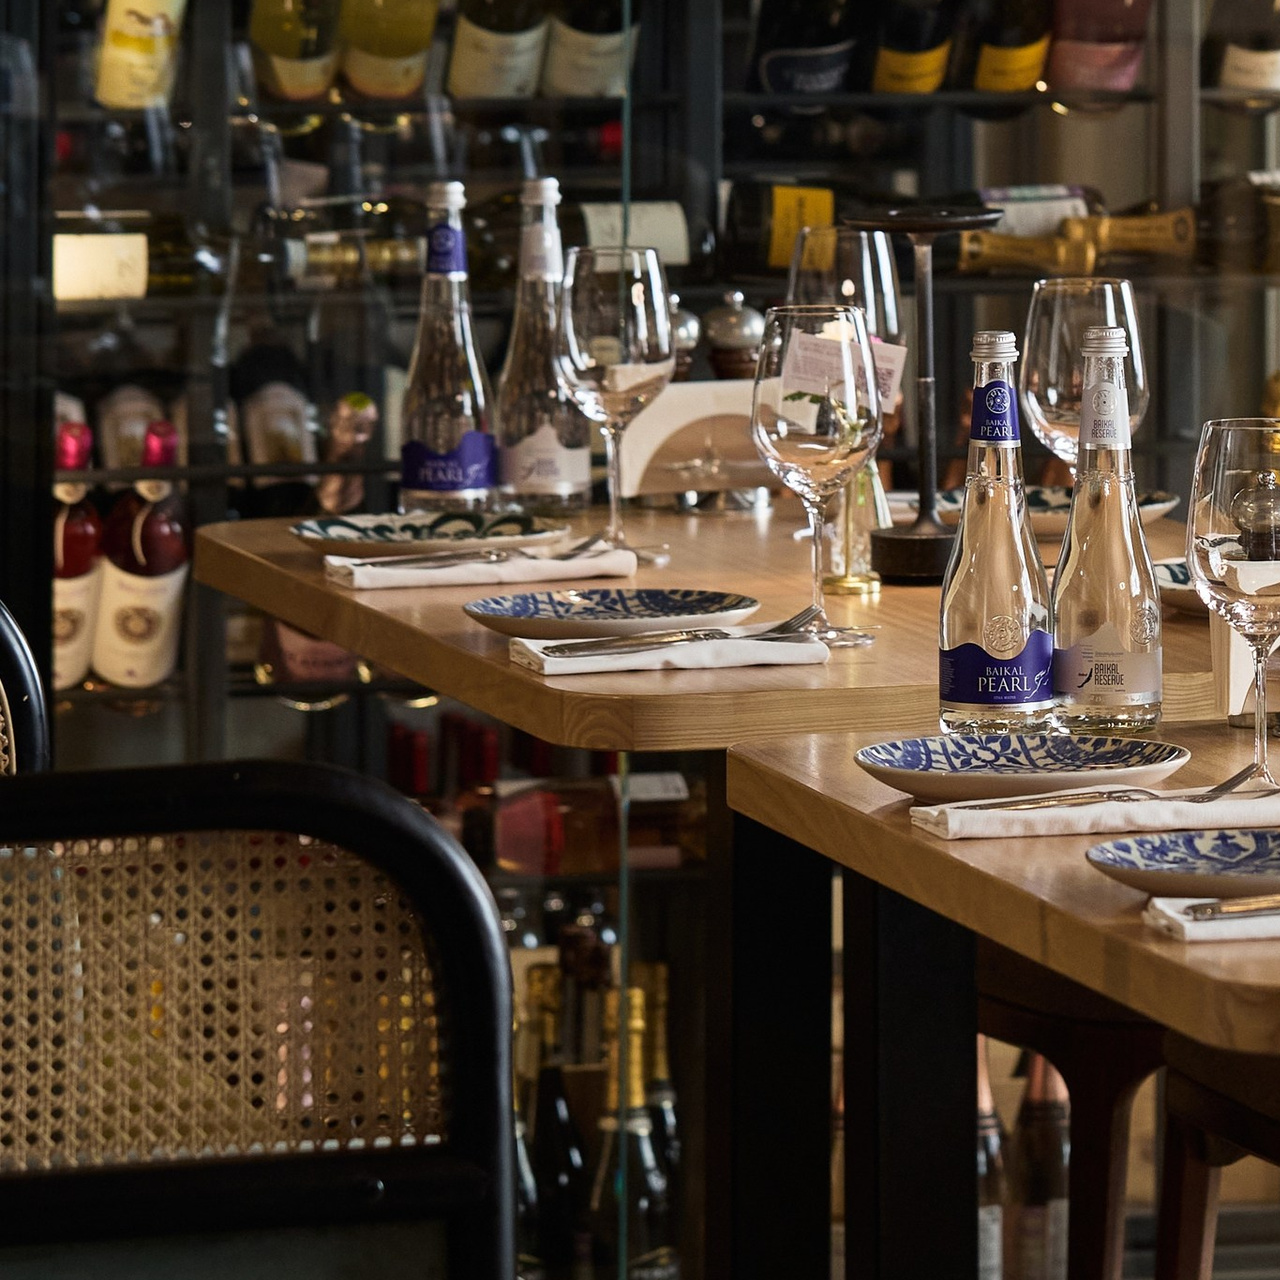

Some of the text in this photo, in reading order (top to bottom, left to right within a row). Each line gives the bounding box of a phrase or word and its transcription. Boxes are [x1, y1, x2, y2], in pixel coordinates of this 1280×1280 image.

[1093, 419, 1115, 429] BAIKAL
[980, 426, 1015, 437] PEARL
[1091, 428, 1117, 439] RESERVE
[986, 666, 1024, 676] BAIKAL
[1094, 663, 1119, 675] BAIKAL
[978, 676, 1031, 692] PEARL
[1094, 674, 1124, 686] RESERVE
